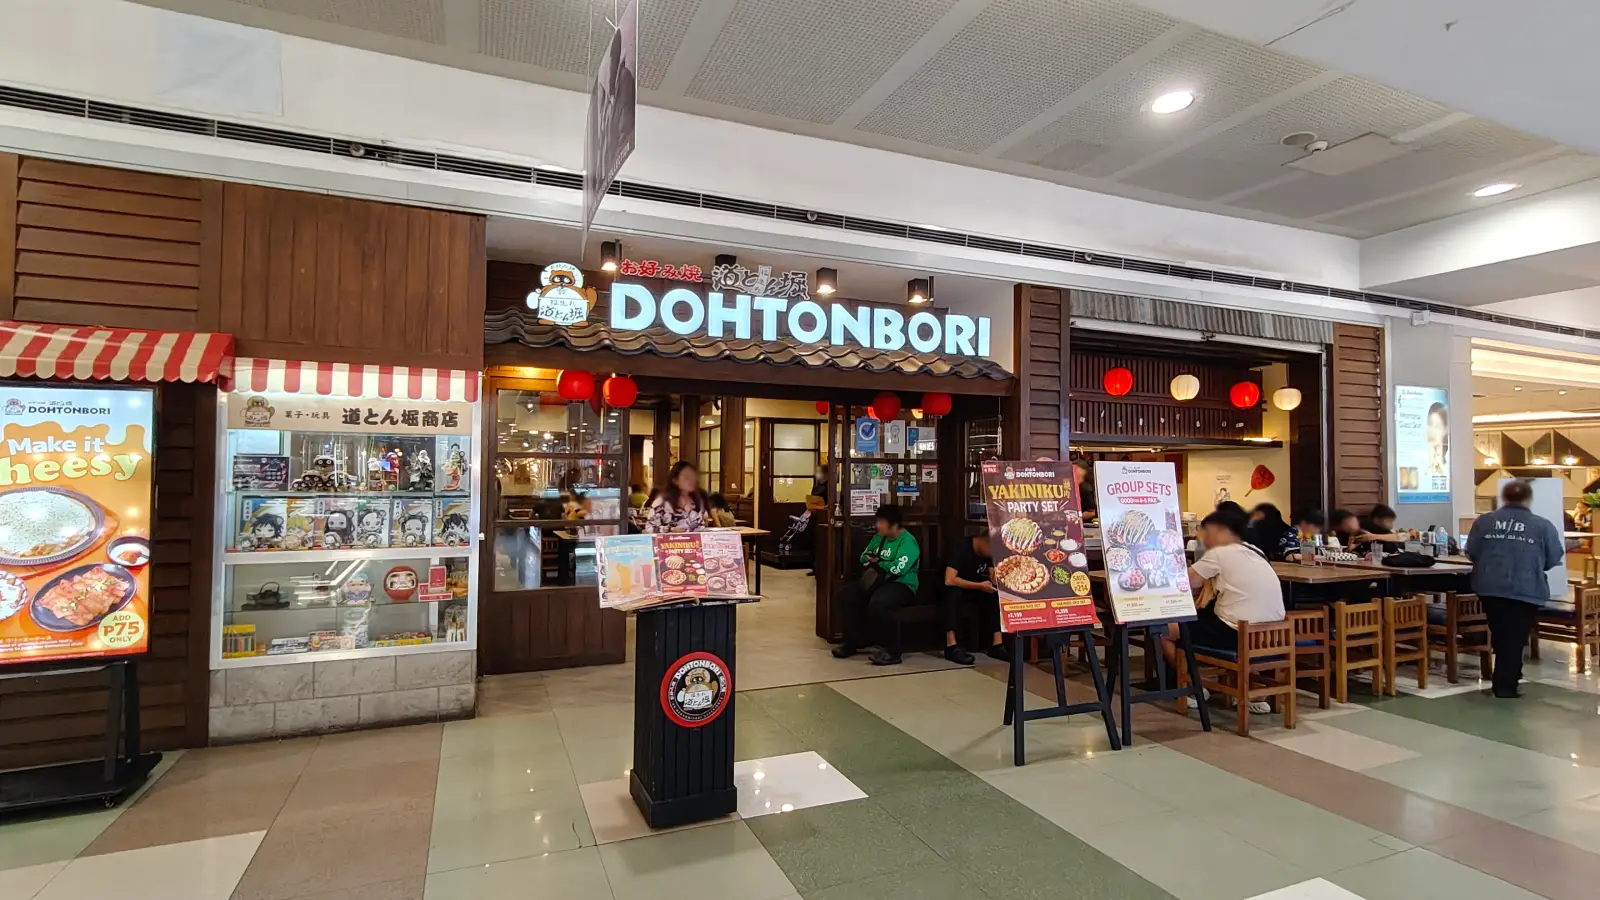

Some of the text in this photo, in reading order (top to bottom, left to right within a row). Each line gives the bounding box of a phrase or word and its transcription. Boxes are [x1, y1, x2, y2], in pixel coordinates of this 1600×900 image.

[621, 259, 703, 282] お好み焼
[610, 281, 991, 357] DOHTONBORI
[28, 406, 111, 415] DOHTONBORI
[284, 409, 331, 420] 菓子・玩具
[341, 407, 459, 428] 道とん堀商店
[6, 436, 105, 456] Make it
[0, 454, 143, 486] heesy
[988, 484, 1064, 500] YAKINIKU
[1106, 480, 1172, 496] GROUP SETS
[1007, 501, 1059, 513] PARTY SET
[660, 541, 697, 550] YAKINIKU
[890, 555, 909, 575] Grab
[112, 614, 131, 622] ADD
[674, 660, 722, 681] DOHTONBORI
